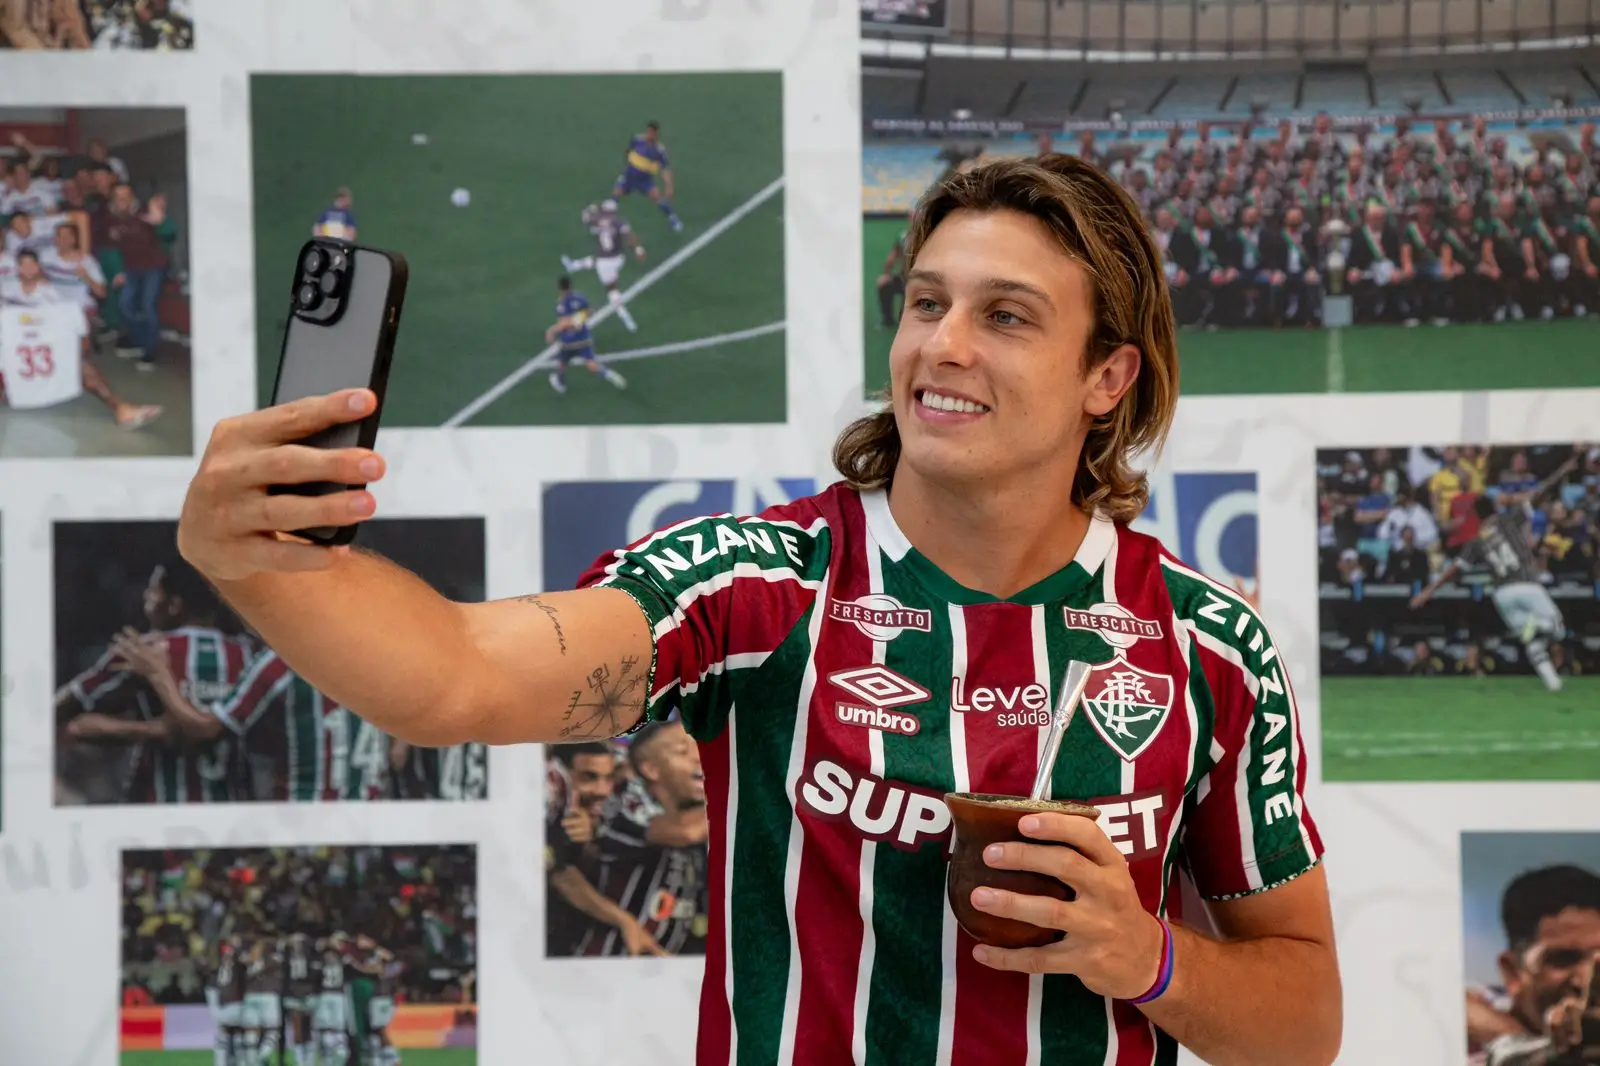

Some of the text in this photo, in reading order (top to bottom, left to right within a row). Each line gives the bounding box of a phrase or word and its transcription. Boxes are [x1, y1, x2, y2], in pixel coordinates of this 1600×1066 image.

[17, 345, 54, 380] 33
[632, 524, 804, 583] NZANE
[833, 604, 925, 626] FRESCATTO
[1069, 613, 1155, 635] FRESCATTO
[951, 677, 1047, 712] Leve
[838, 705, 917, 733] umbro
[997, 709, 1049, 727] saúde
[802, 760, 1164, 854] SUPET
